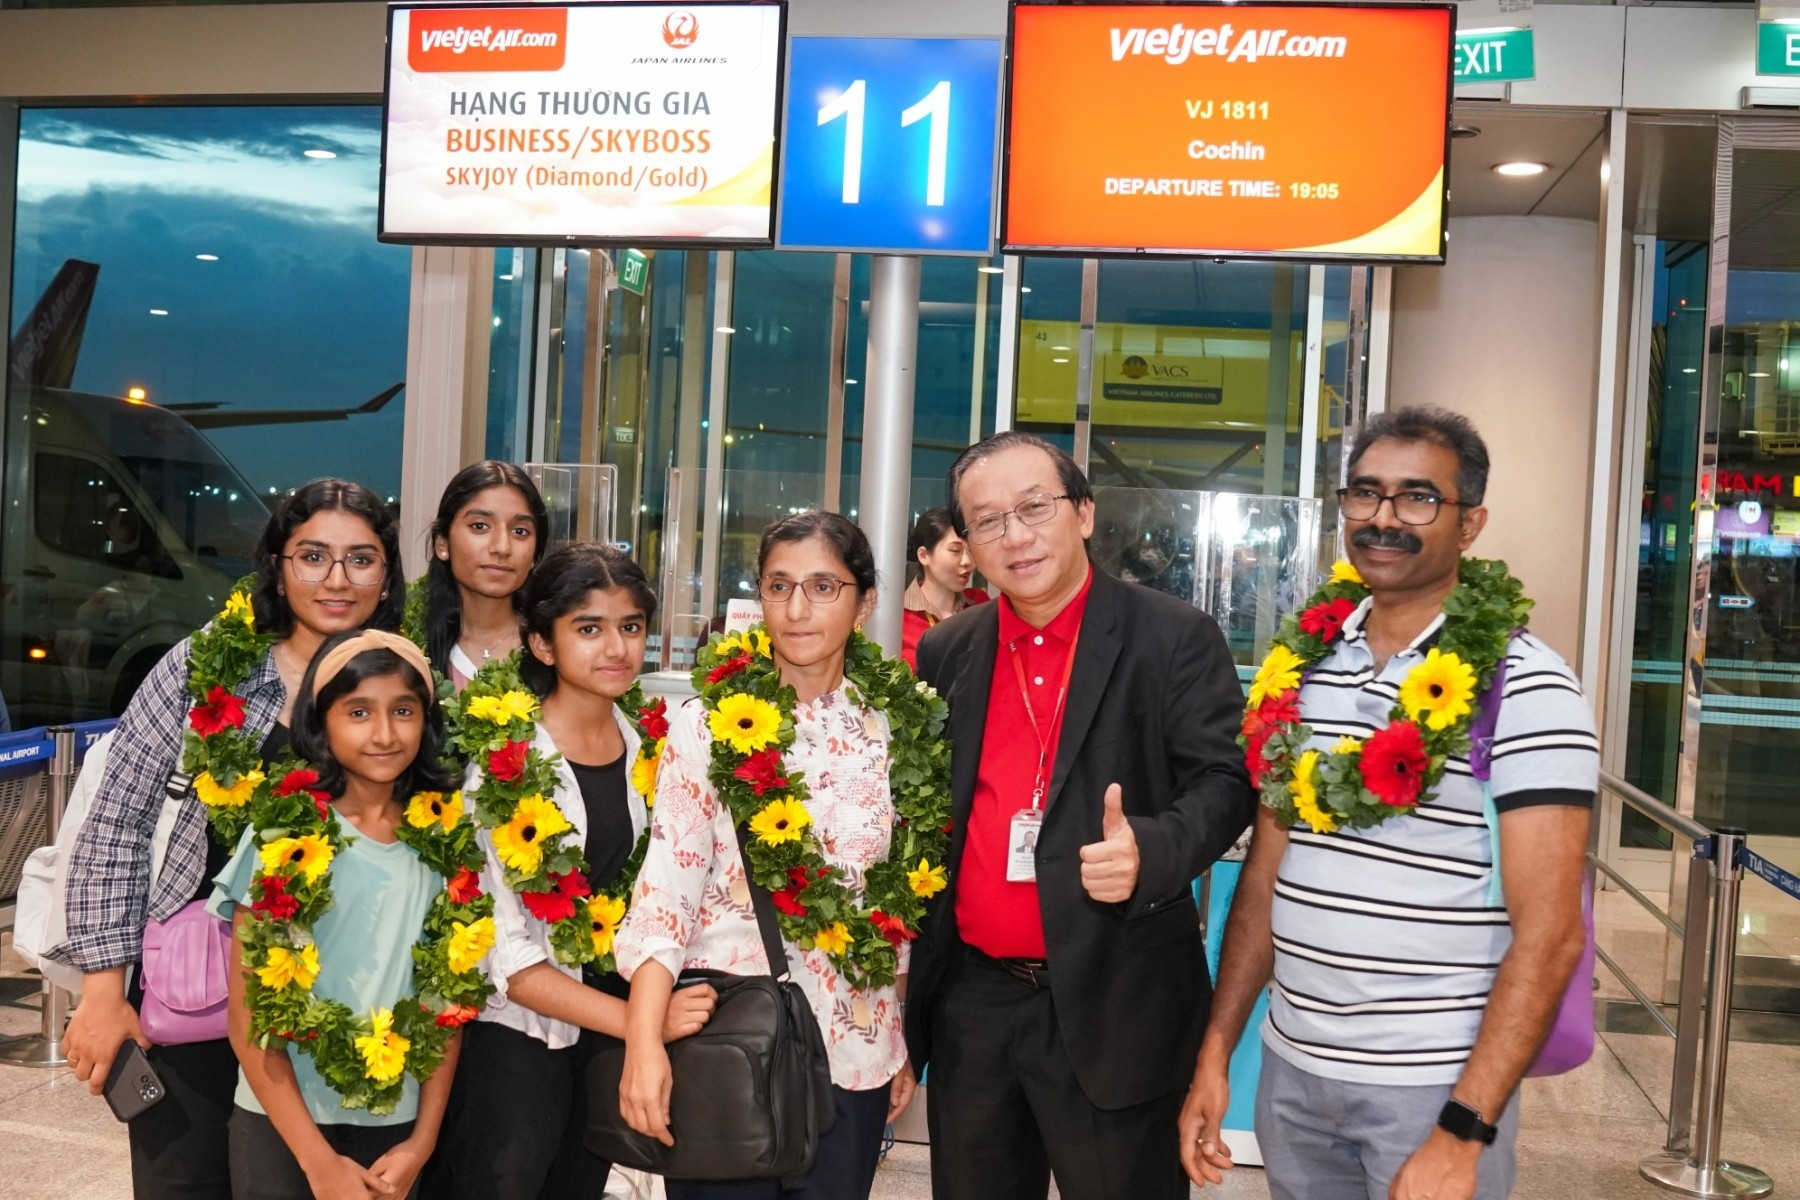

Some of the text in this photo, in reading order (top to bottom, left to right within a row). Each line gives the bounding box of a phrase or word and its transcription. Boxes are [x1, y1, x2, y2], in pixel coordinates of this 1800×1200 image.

[450, 88, 712, 122] HẠNG THƯƠNG GIA
[1185, 100, 1270, 120] VJ 1811
[446, 126, 712, 159] BUSINESS/SKYBOSS
[816, 80, 951, 207] 11
[1187, 140, 1266, 161] Cochin
[446, 165, 708, 192] SKYJOY (Diamond/Gold)
[1104, 177, 1340, 199] DEPARTURE TIME: 19:05
[624, 257, 643, 285] EXIT
[1151, 364, 1189, 378] VACS
[1108, 388, 1138, 396] VIETNAM
[12, 746, 40, 760] AIRPORT
[1748, 852, 1764, 876] TIA
